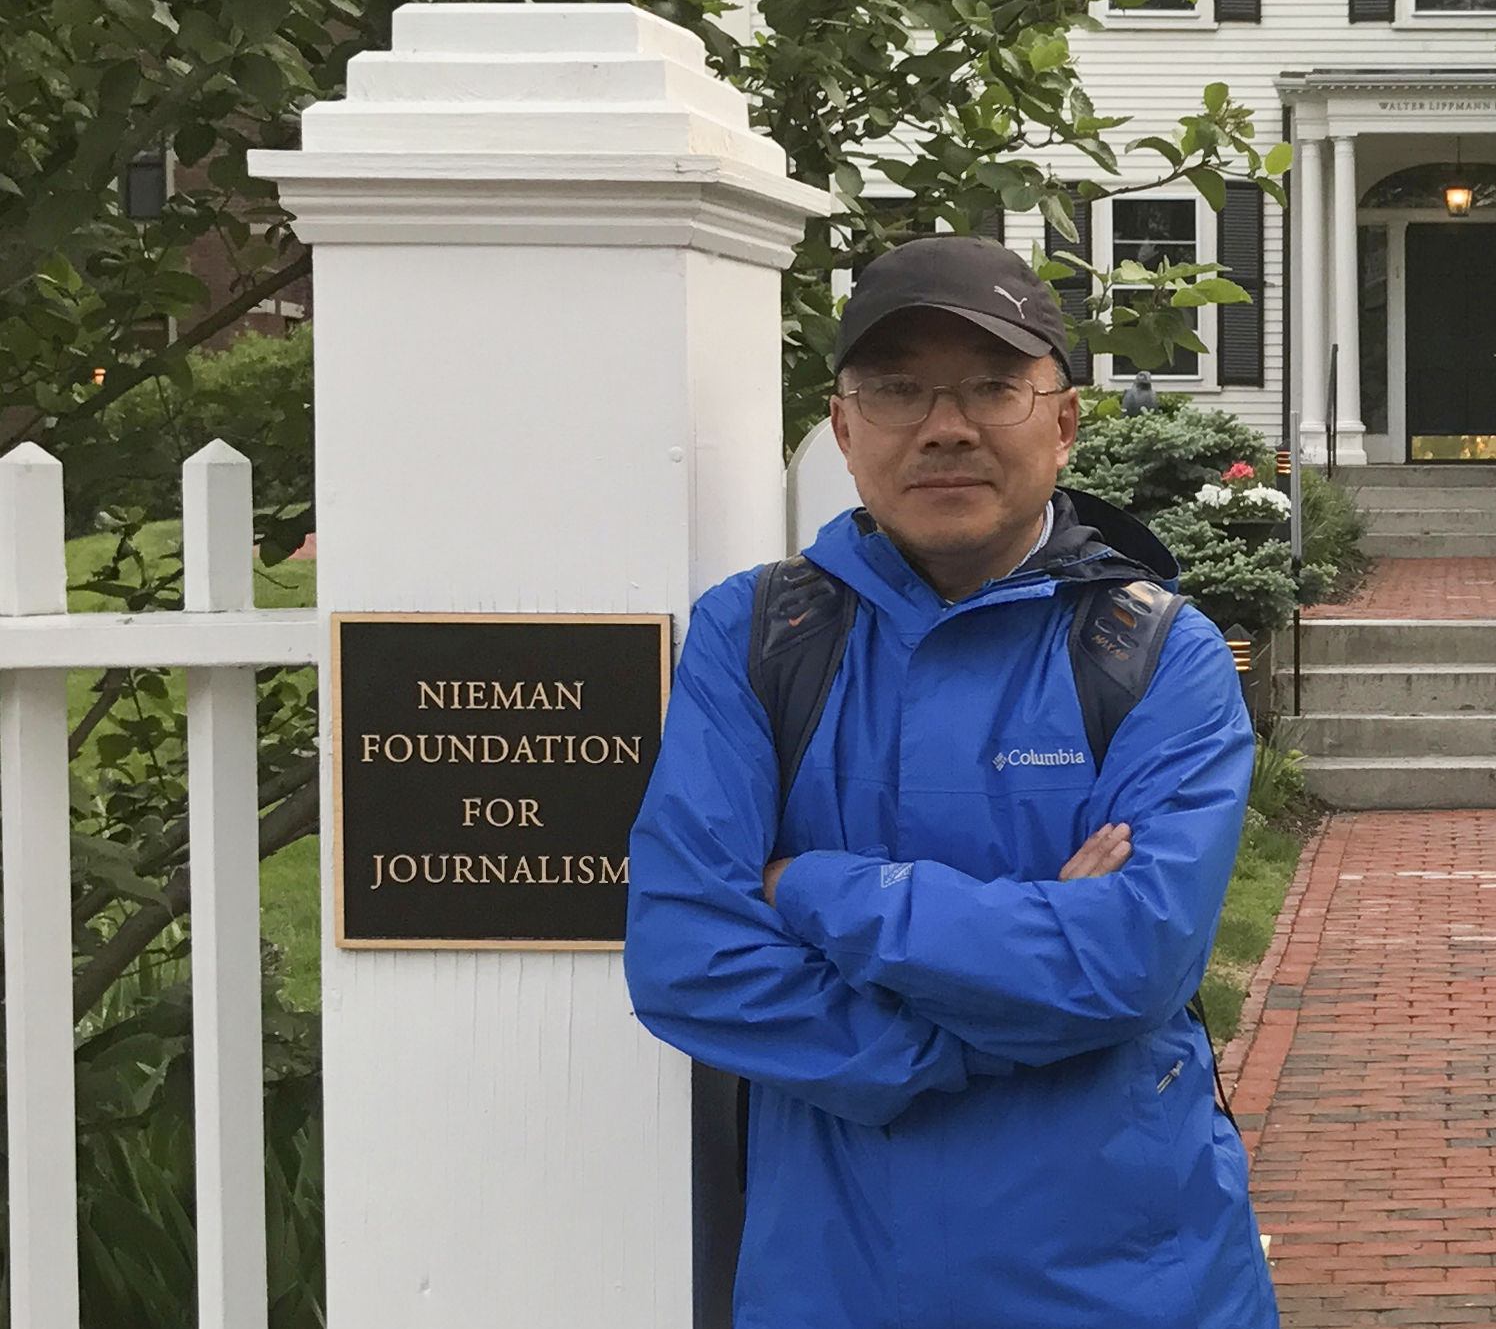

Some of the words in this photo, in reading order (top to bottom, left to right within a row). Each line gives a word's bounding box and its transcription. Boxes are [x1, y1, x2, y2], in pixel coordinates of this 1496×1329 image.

[1379, 101, 1425, 111] WALTER
[1429, 101, 1491, 111] LIPPMANN
[417, 680, 584, 710] NIEMAN
[361, 733, 643, 764] FOUNDATION
[1008, 748, 1085, 766] Columbia
[462, 797, 544, 827] FOR
[371, 854, 630, 890] JOURNALISM
